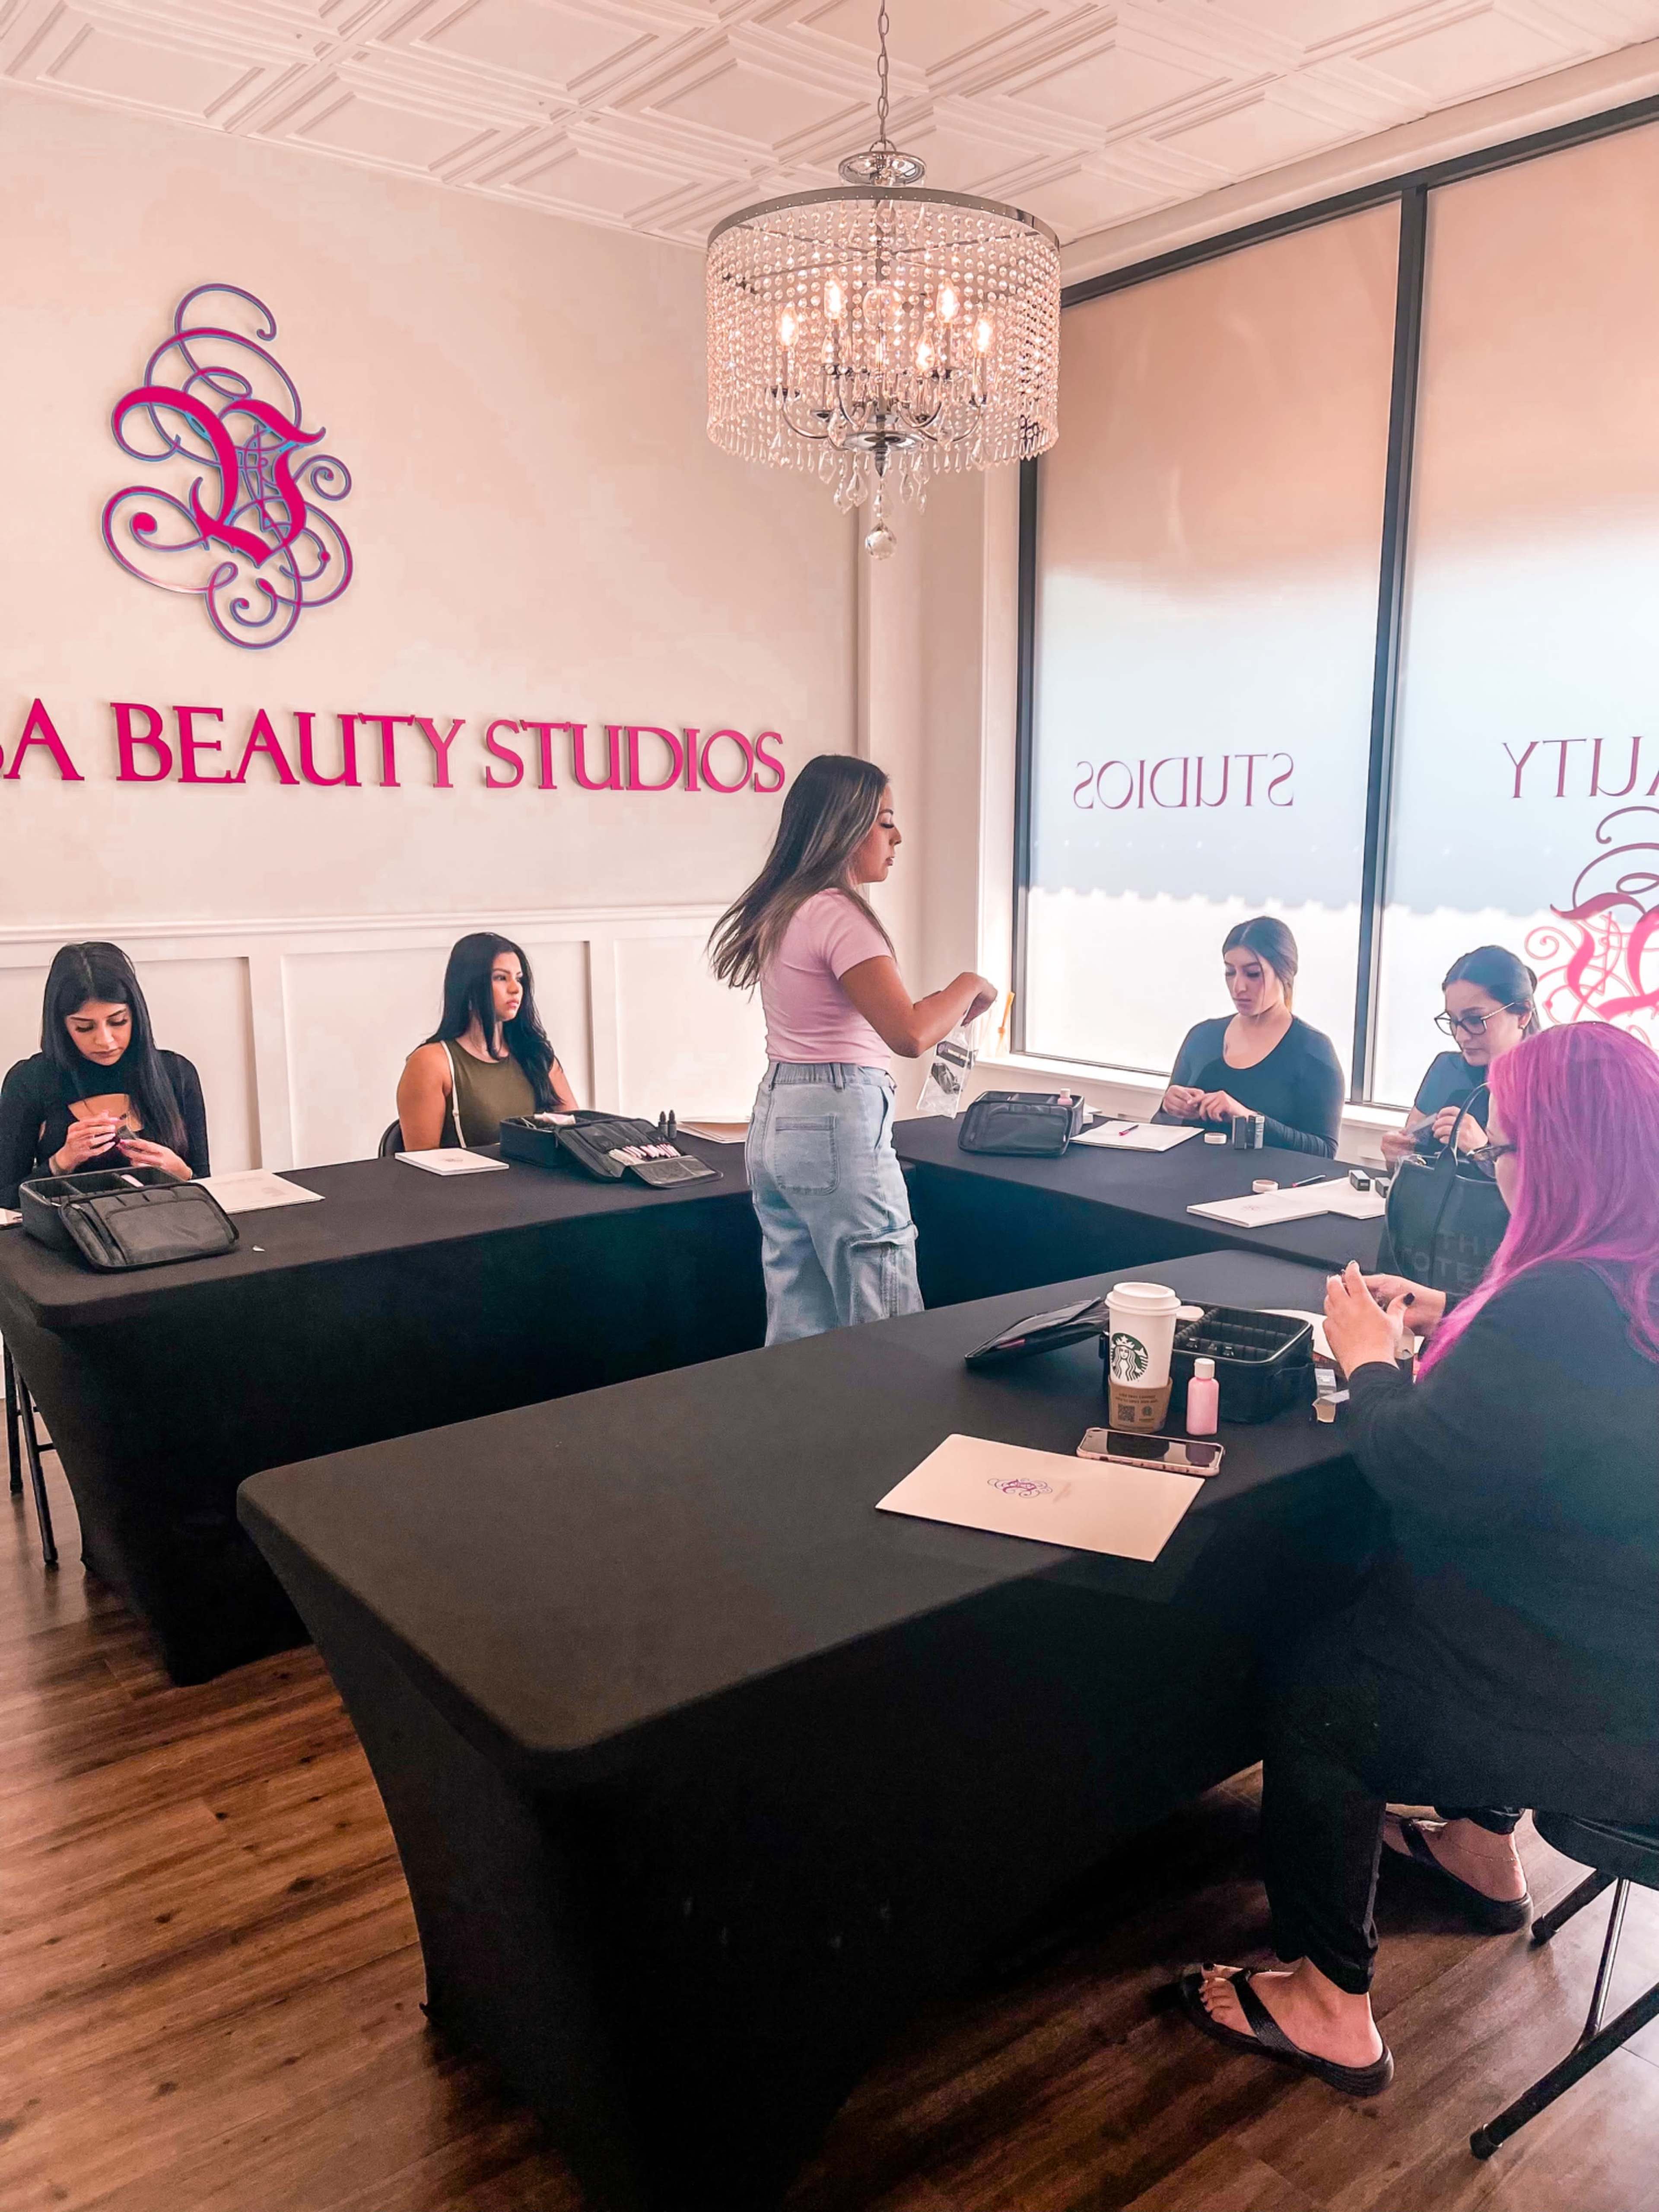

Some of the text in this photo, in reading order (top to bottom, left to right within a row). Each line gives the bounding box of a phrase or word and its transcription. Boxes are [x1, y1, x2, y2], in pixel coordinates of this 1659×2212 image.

[0, 698, 785, 793] A BEAUTY STUDIOS
